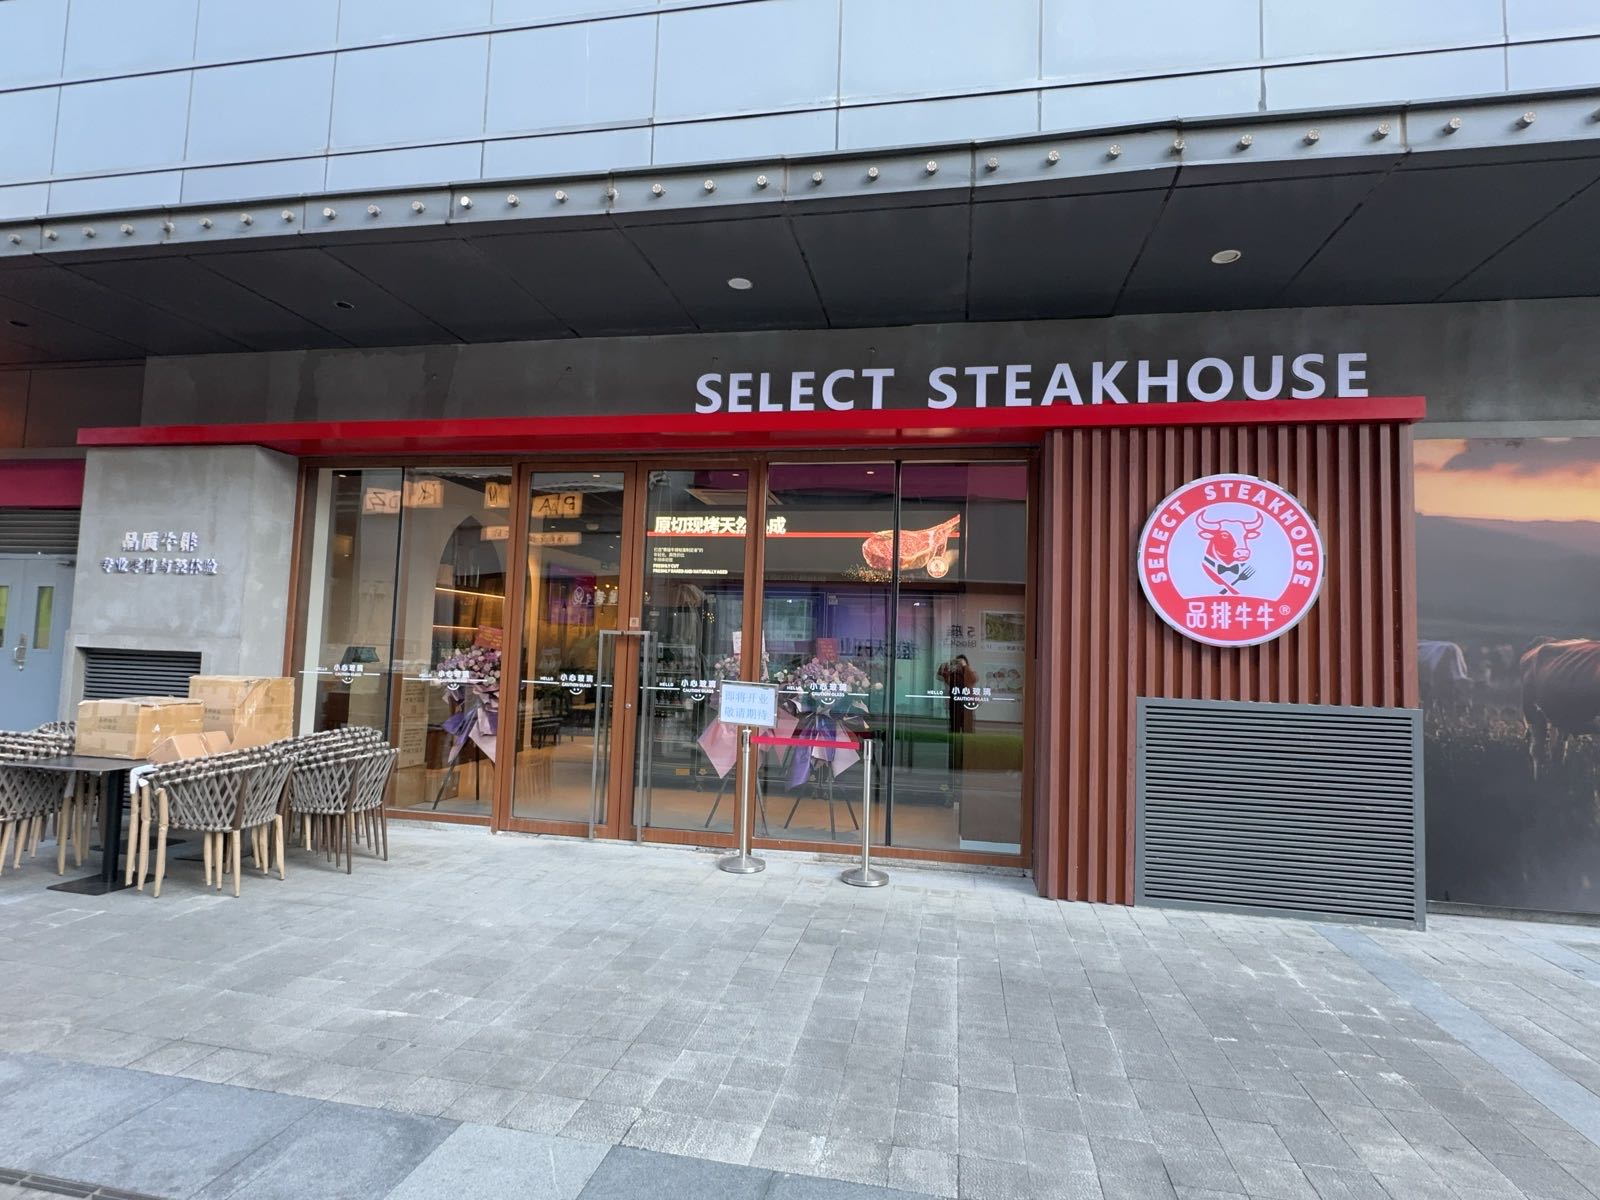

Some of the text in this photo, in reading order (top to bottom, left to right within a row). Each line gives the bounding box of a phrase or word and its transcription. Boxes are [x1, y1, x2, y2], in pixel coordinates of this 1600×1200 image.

[695, 352, 1369, 415] SELECT STEAKHOUSE
[655, 516, 787, 534] 原切现烤天然成
[1147, 483, 1314, 588] SELECT STEAKHOUSE
[1186, 601, 1275, 630] 品排牛牛
[560, 673, 594, 683] 小心玻璃
[681, 679, 717, 688] 小心玻璃
[809, 683, 848, 692] 小心玻璃
[951, 686, 992, 697] 小心玻璃
[725, 690, 769, 705] 即将开业
[724, 707, 769, 721] 敬请期待
